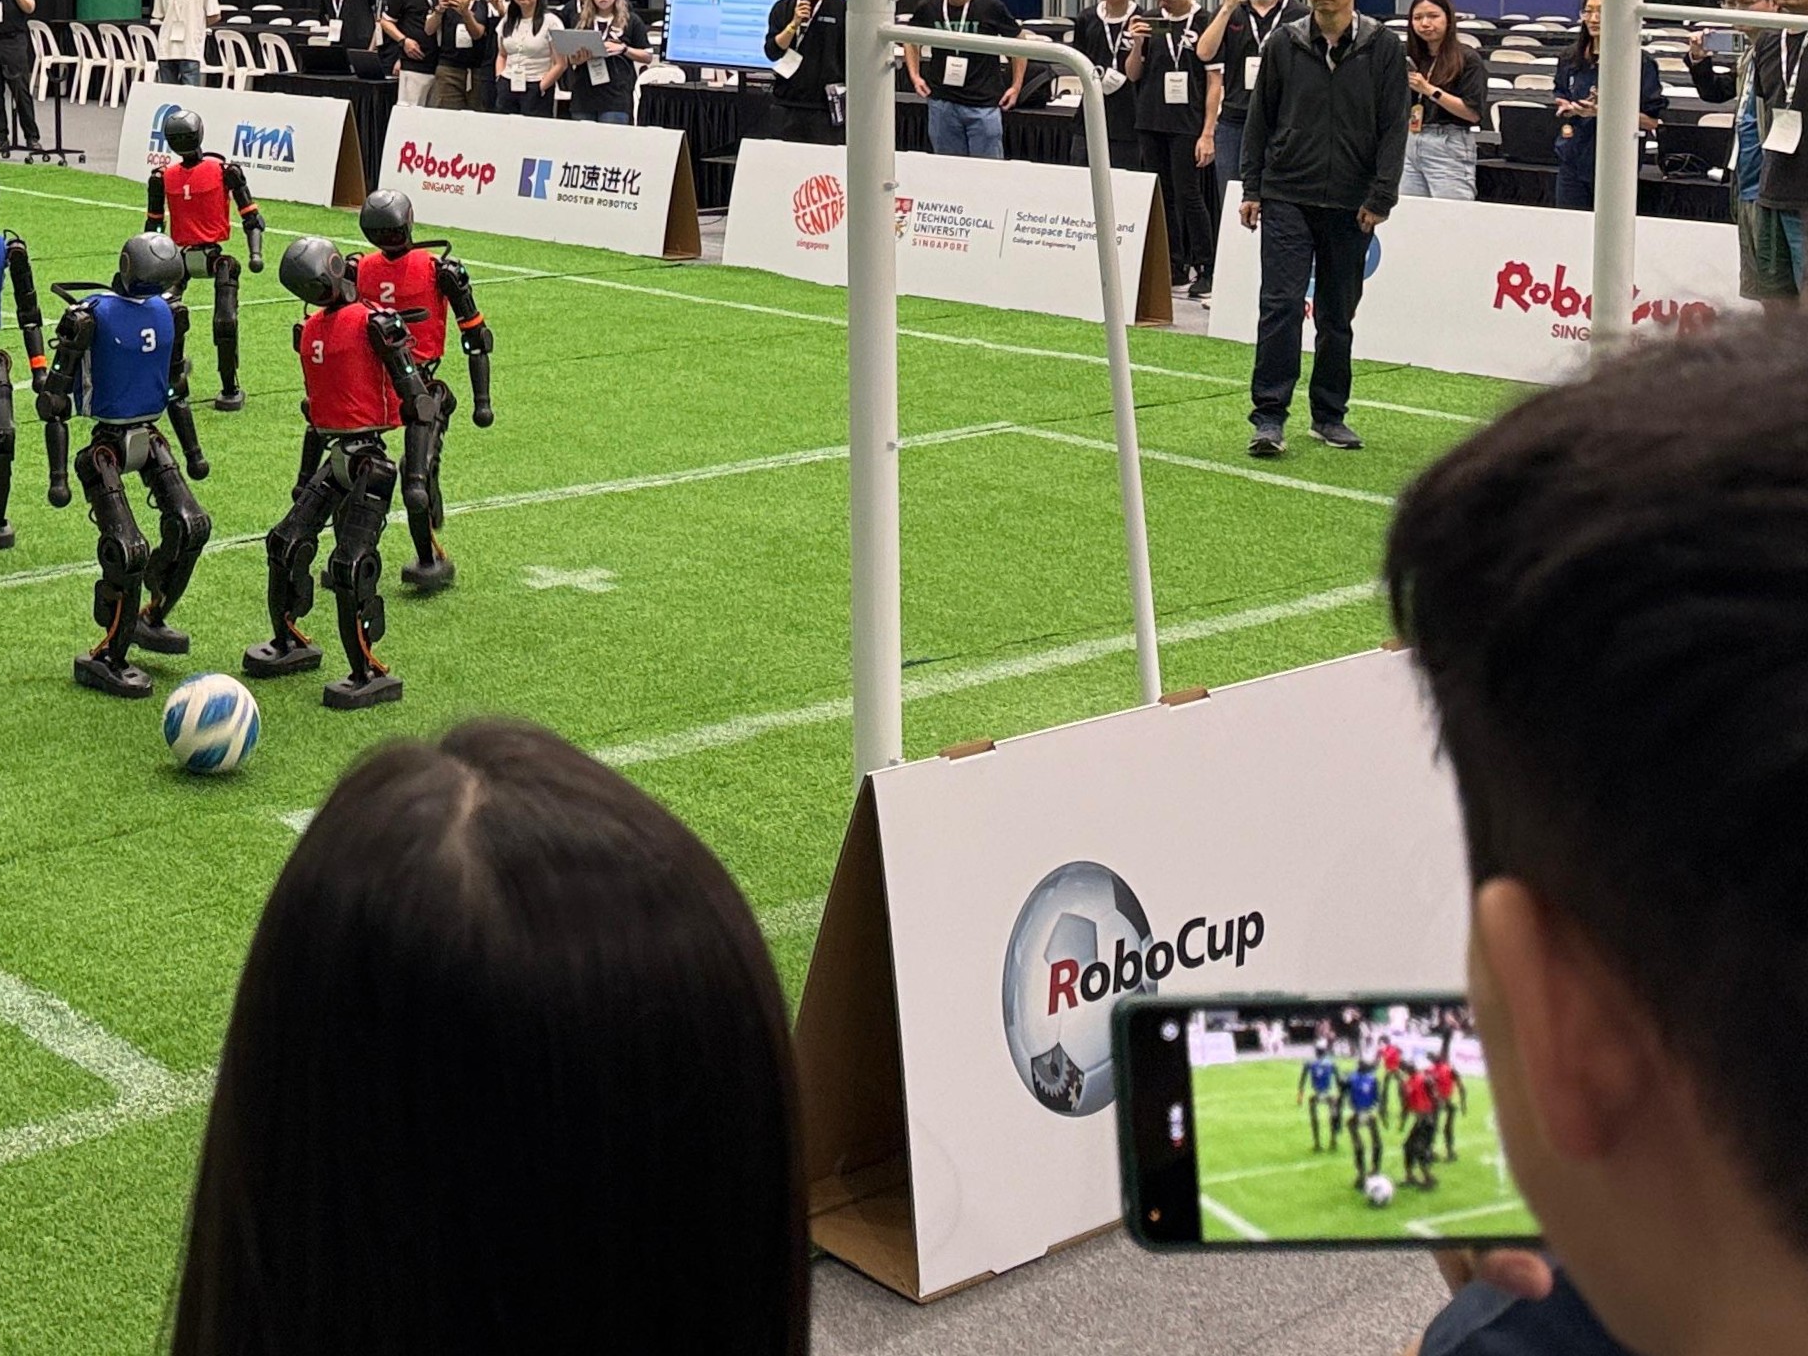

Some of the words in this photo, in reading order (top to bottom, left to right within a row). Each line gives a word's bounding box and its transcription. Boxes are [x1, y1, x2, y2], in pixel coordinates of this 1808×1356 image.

[397, 141, 496, 195] RoboCup
[559, 161, 642, 196] 加速进化
[182, 184, 192, 200] 1
[422, 181, 464, 196] SINGAPORE
[793, 175, 843, 214] SCIENCE
[557, 193, 594, 205] BOOSTER
[597, 198, 638, 210] ROBOTICS
[917, 201, 964, 215] NANYANG
[795, 196, 845, 236] CENTRE
[916, 212, 994, 230] TECHNOLOGICAL
[1016, 211, 1047, 224] School
[1050, 215, 1059, 225] of
[1116, 223, 1135, 233] and
[913, 223, 970, 238] UNIVERSITY
[1014, 223, 1063, 237] Aerospace
[912, 238, 969, 252] SINGAPORE
[379, 281, 395, 303] 2
[141, 327, 157, 353] 3
[311, 340, 324, 364] 3
[1048, 911, 1265, 1016] RoboCup
